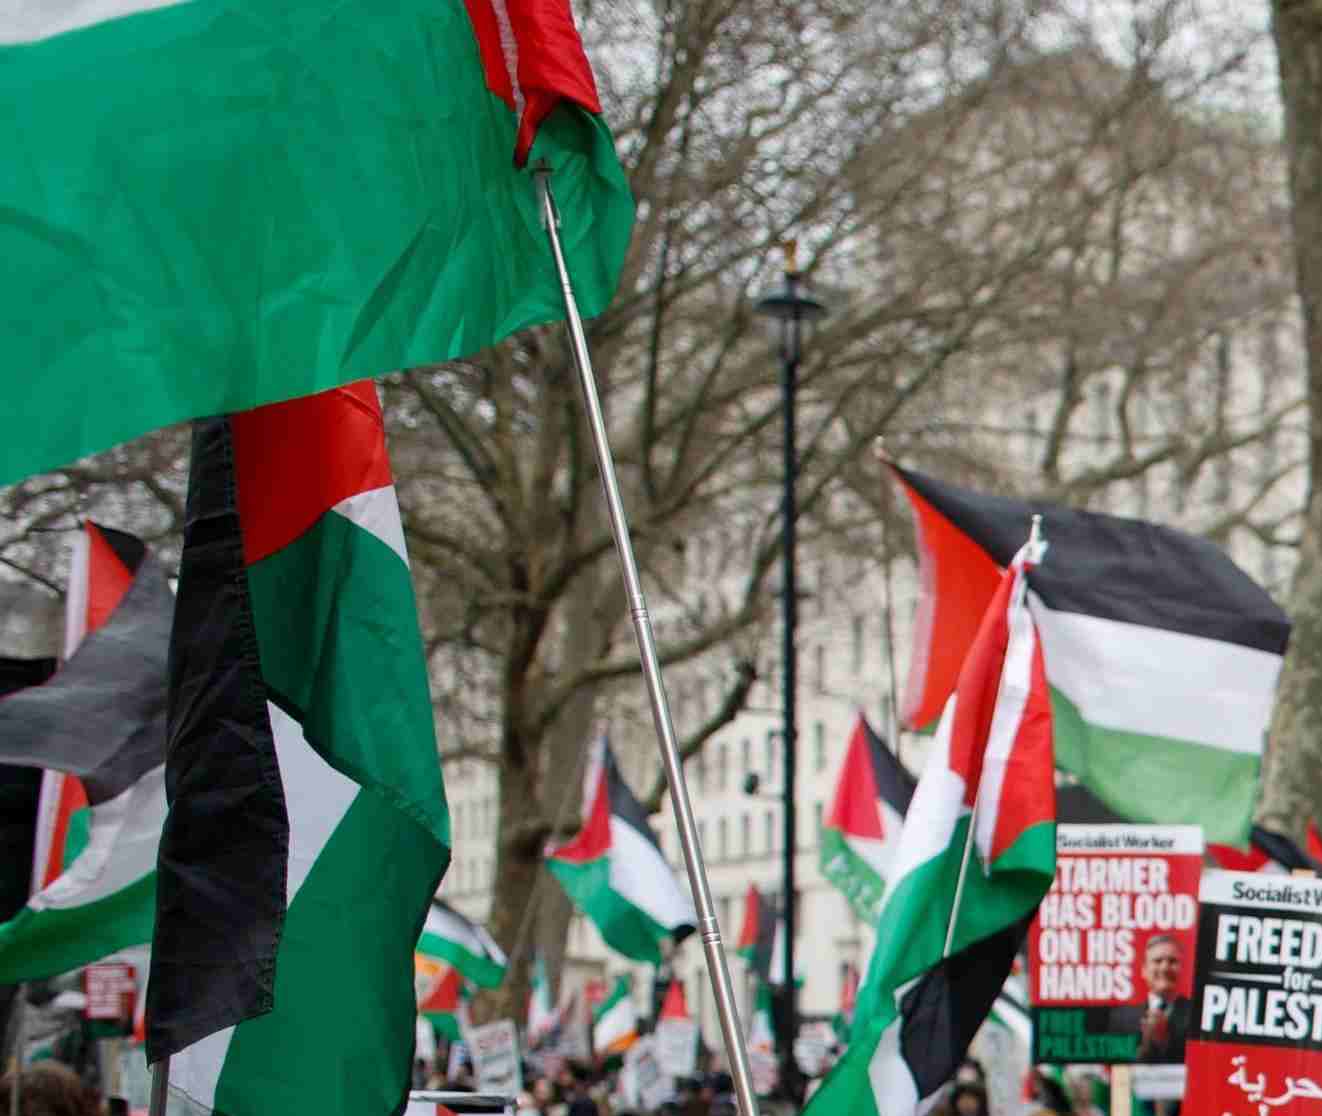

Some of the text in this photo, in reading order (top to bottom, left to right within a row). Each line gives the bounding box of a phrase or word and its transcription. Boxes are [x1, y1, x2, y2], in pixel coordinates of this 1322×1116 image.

[1052, 857, 1168, 893] TARMER
[1040, 893, 1196, 930] HAS BLOOD
[1233, 881, 1311, 907] Socialist
[1039, 928, 1136, 965] ON HIS
[1039, 964, 1133, 1000] HANDS
[1283, 966, 1313, 991] for
